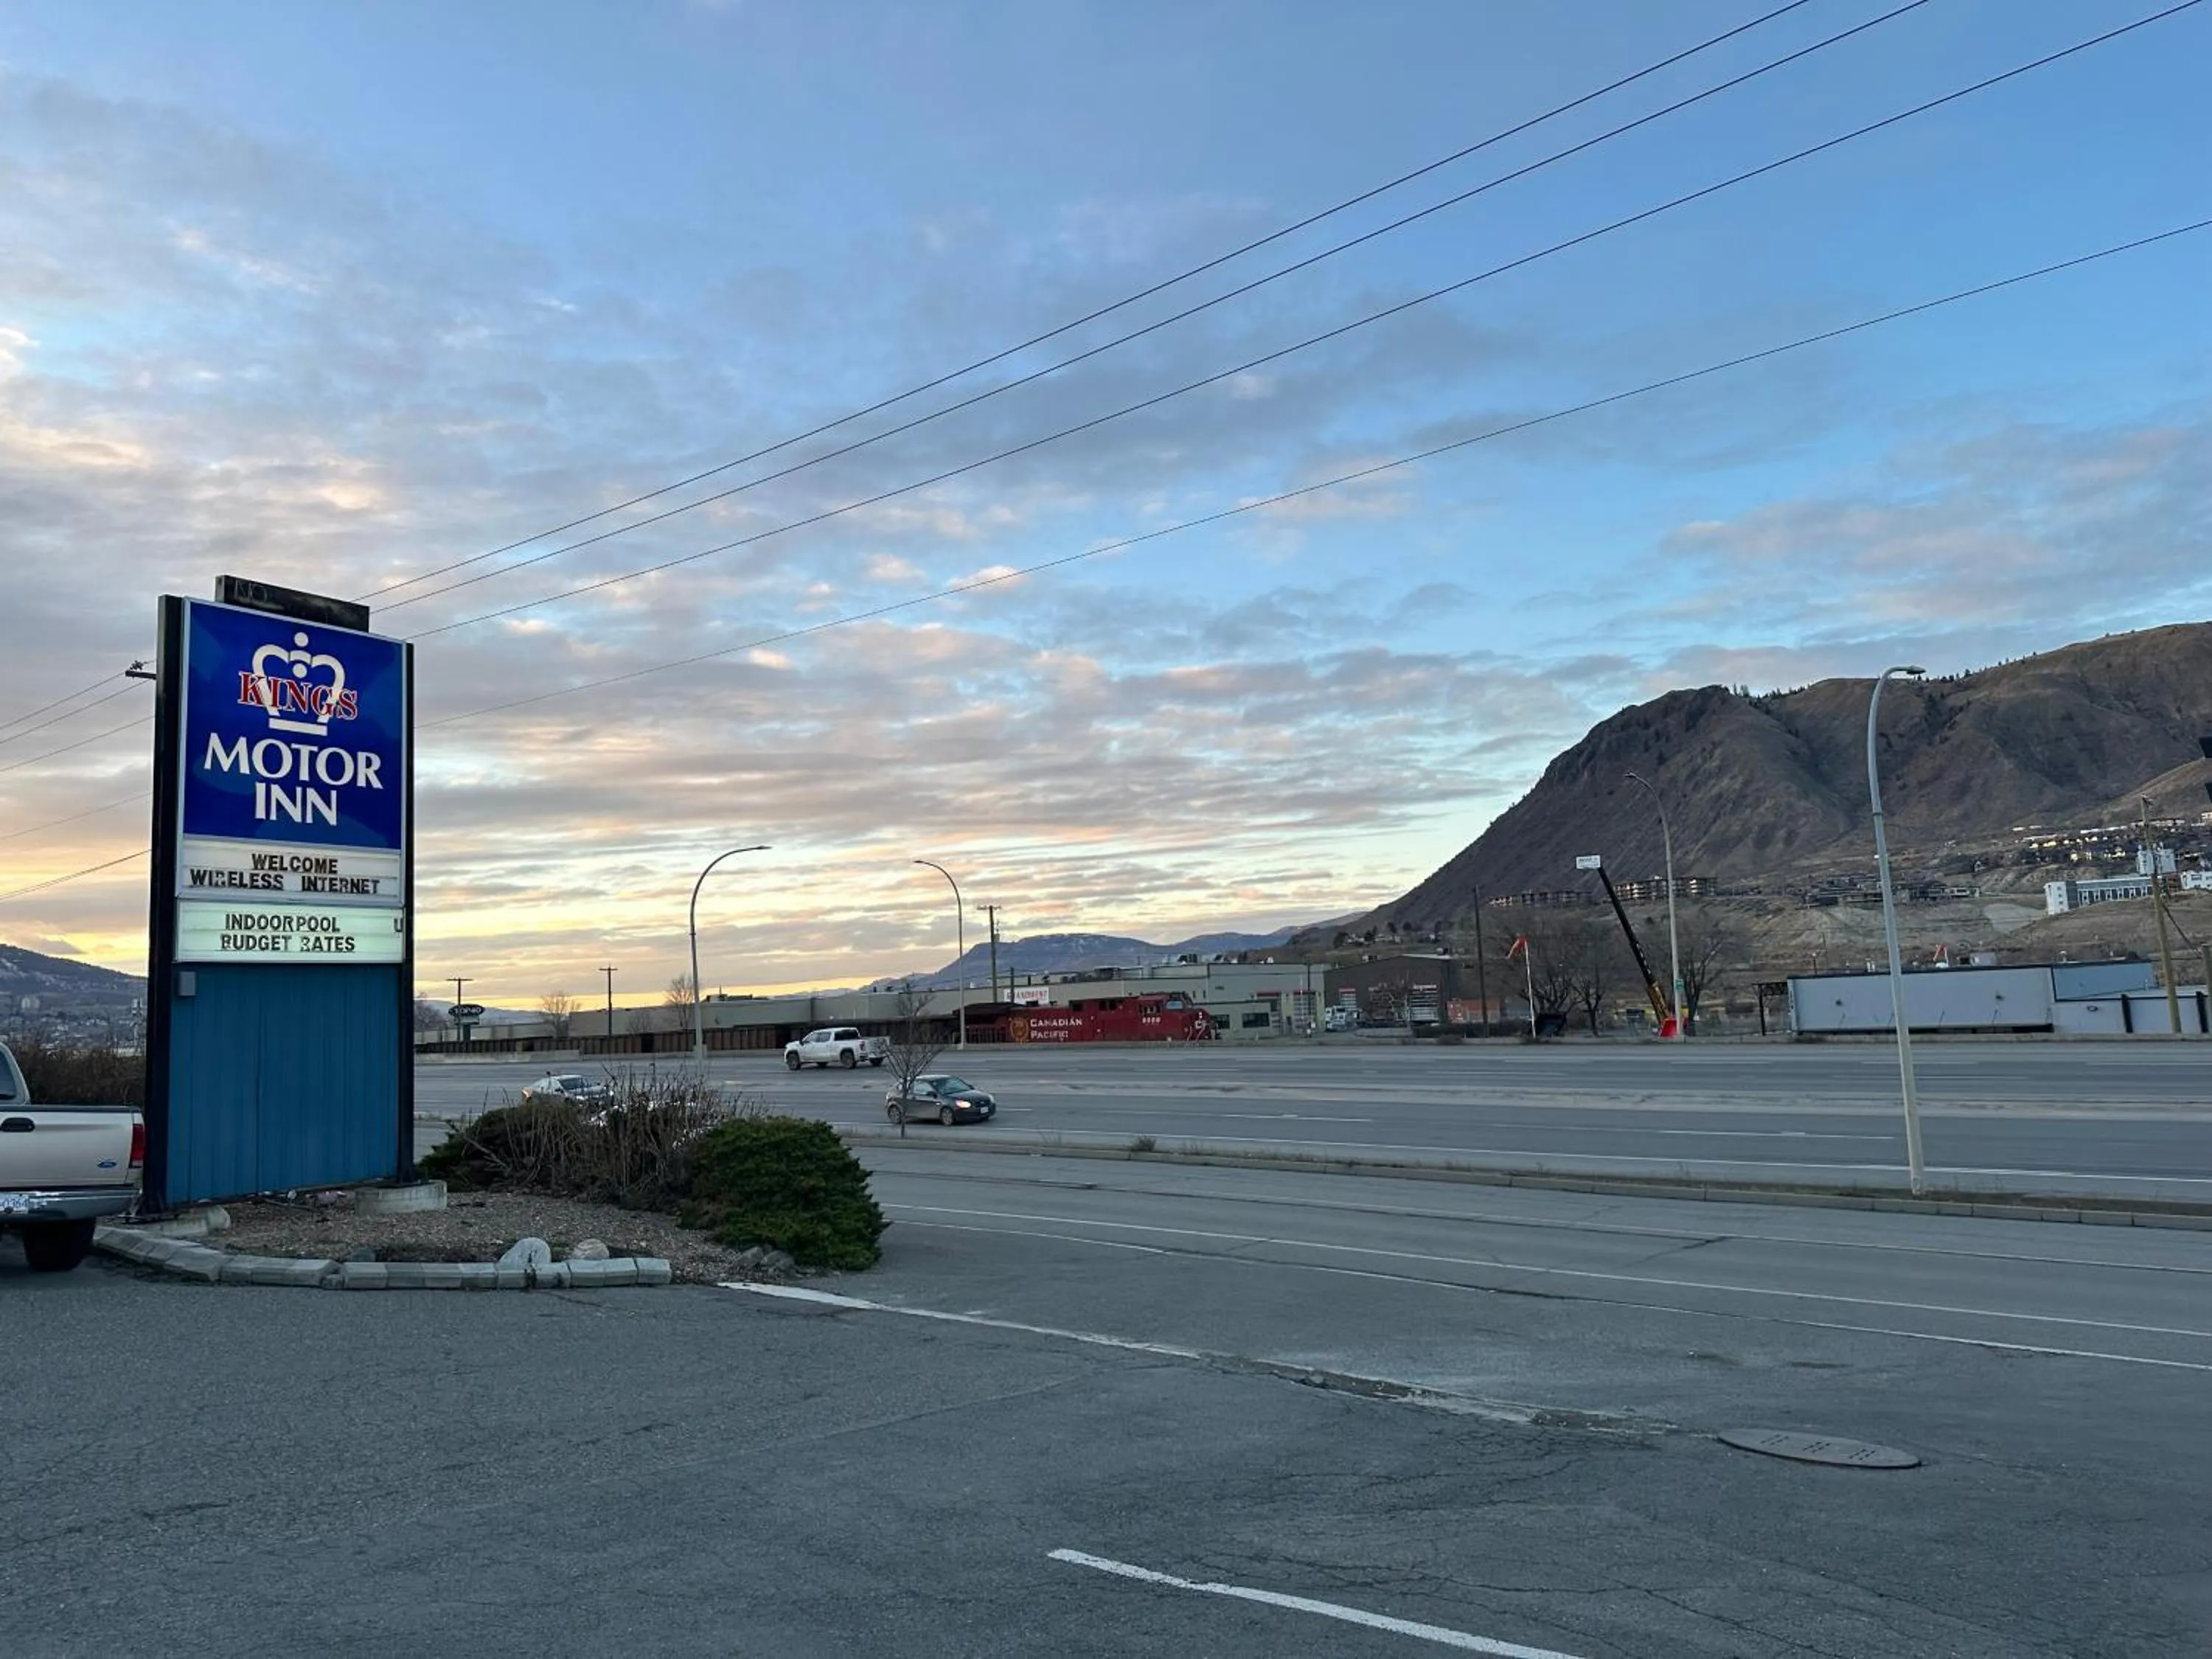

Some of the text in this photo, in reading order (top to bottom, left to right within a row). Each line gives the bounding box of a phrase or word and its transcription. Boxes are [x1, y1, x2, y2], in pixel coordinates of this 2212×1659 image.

[237, 671, 358, 720] KINGS
[204, 732, 383, 789] MOTOR
[254, 782, 337, 826] INN
[251, 853, 338, 874] WELCOME
[189, 869, 380, 894] WIRELESS INTERNET
[225, 914, 293, 932] INDOOR
[296, 916, 341, 933] POOL
[220, 933, 355, 953] BUDGET RATES
[1030, 1017, 1083, 1027] CANADIAN
[1031, 1030, 1068, 1039] PACIFIC
